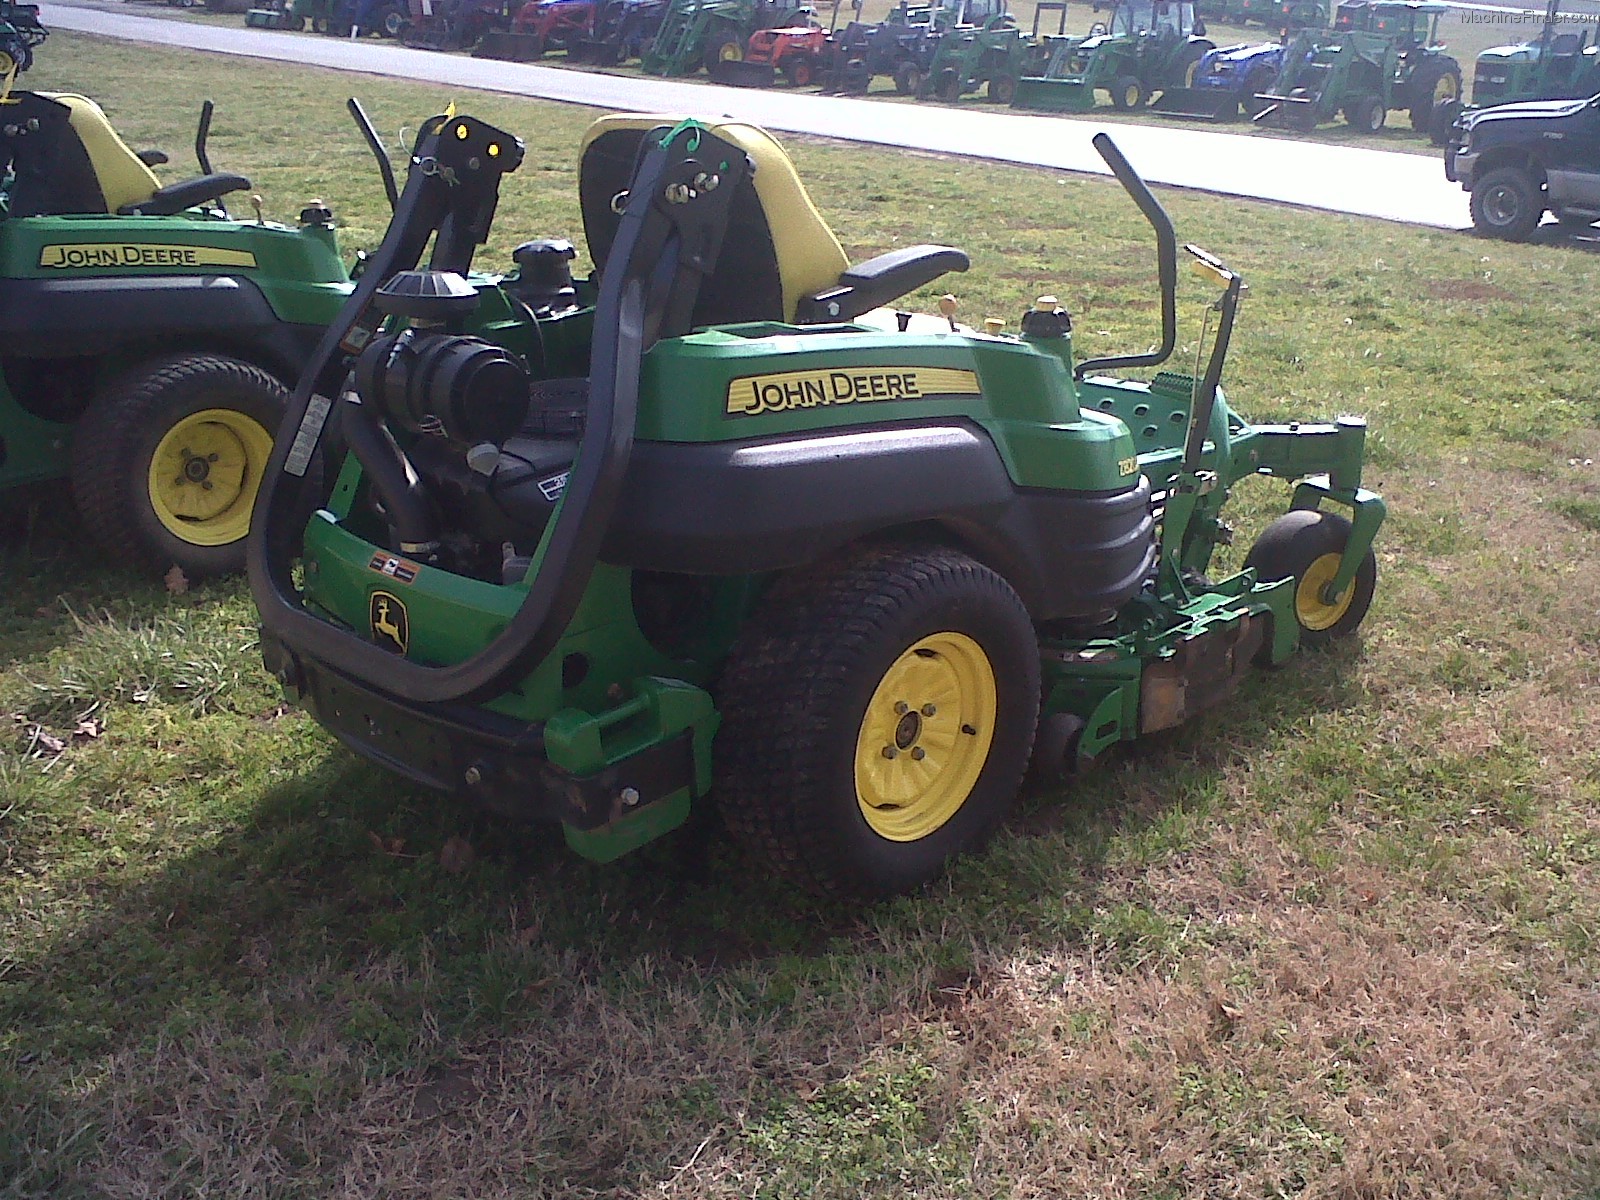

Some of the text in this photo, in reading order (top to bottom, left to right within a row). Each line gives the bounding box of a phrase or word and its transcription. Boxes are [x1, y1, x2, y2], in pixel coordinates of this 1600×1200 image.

[54, 246, 196, 265] JOHN DEERE
[744, 372, 920, 412] JOHN DEERE
